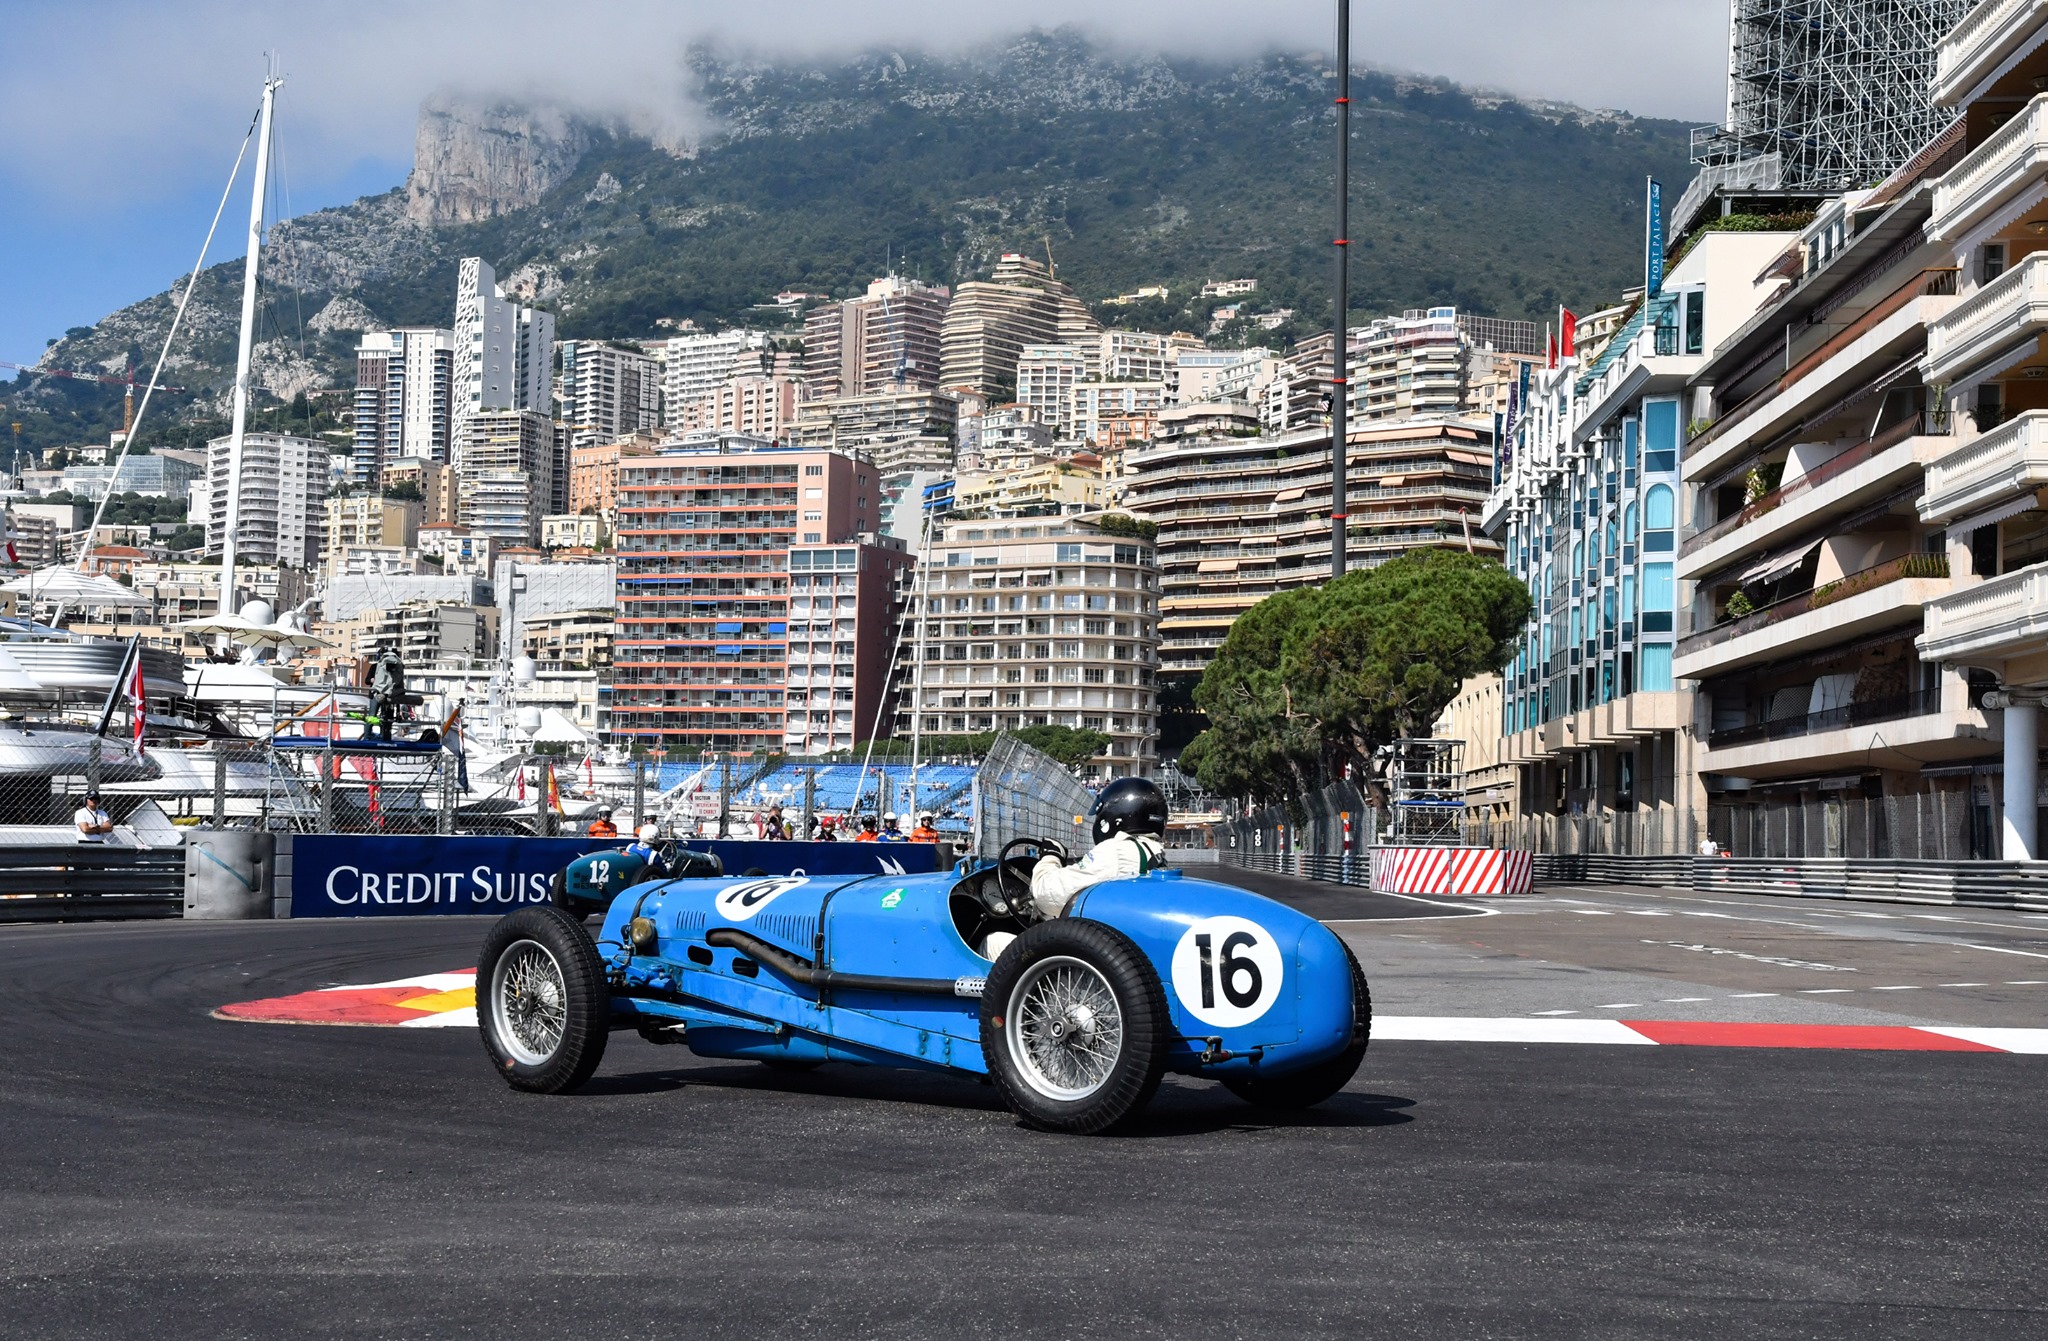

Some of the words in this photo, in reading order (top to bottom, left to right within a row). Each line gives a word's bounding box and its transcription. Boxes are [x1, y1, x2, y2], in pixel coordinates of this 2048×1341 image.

[1652, 202, 1661, 247] PALACE
[1651, 252, 1660, 280] PORT
[1230, 836, 1236, 848] 50
[1254, 829, 1262, 847] 100
[325, 865, 464, 905] CREDIT
[471, 865, 558, 903] SUIS
[589, 860, 610, 883] 12
[725, 879, 799, 907] 16
[1195, 931, 1263, 1009] 16
